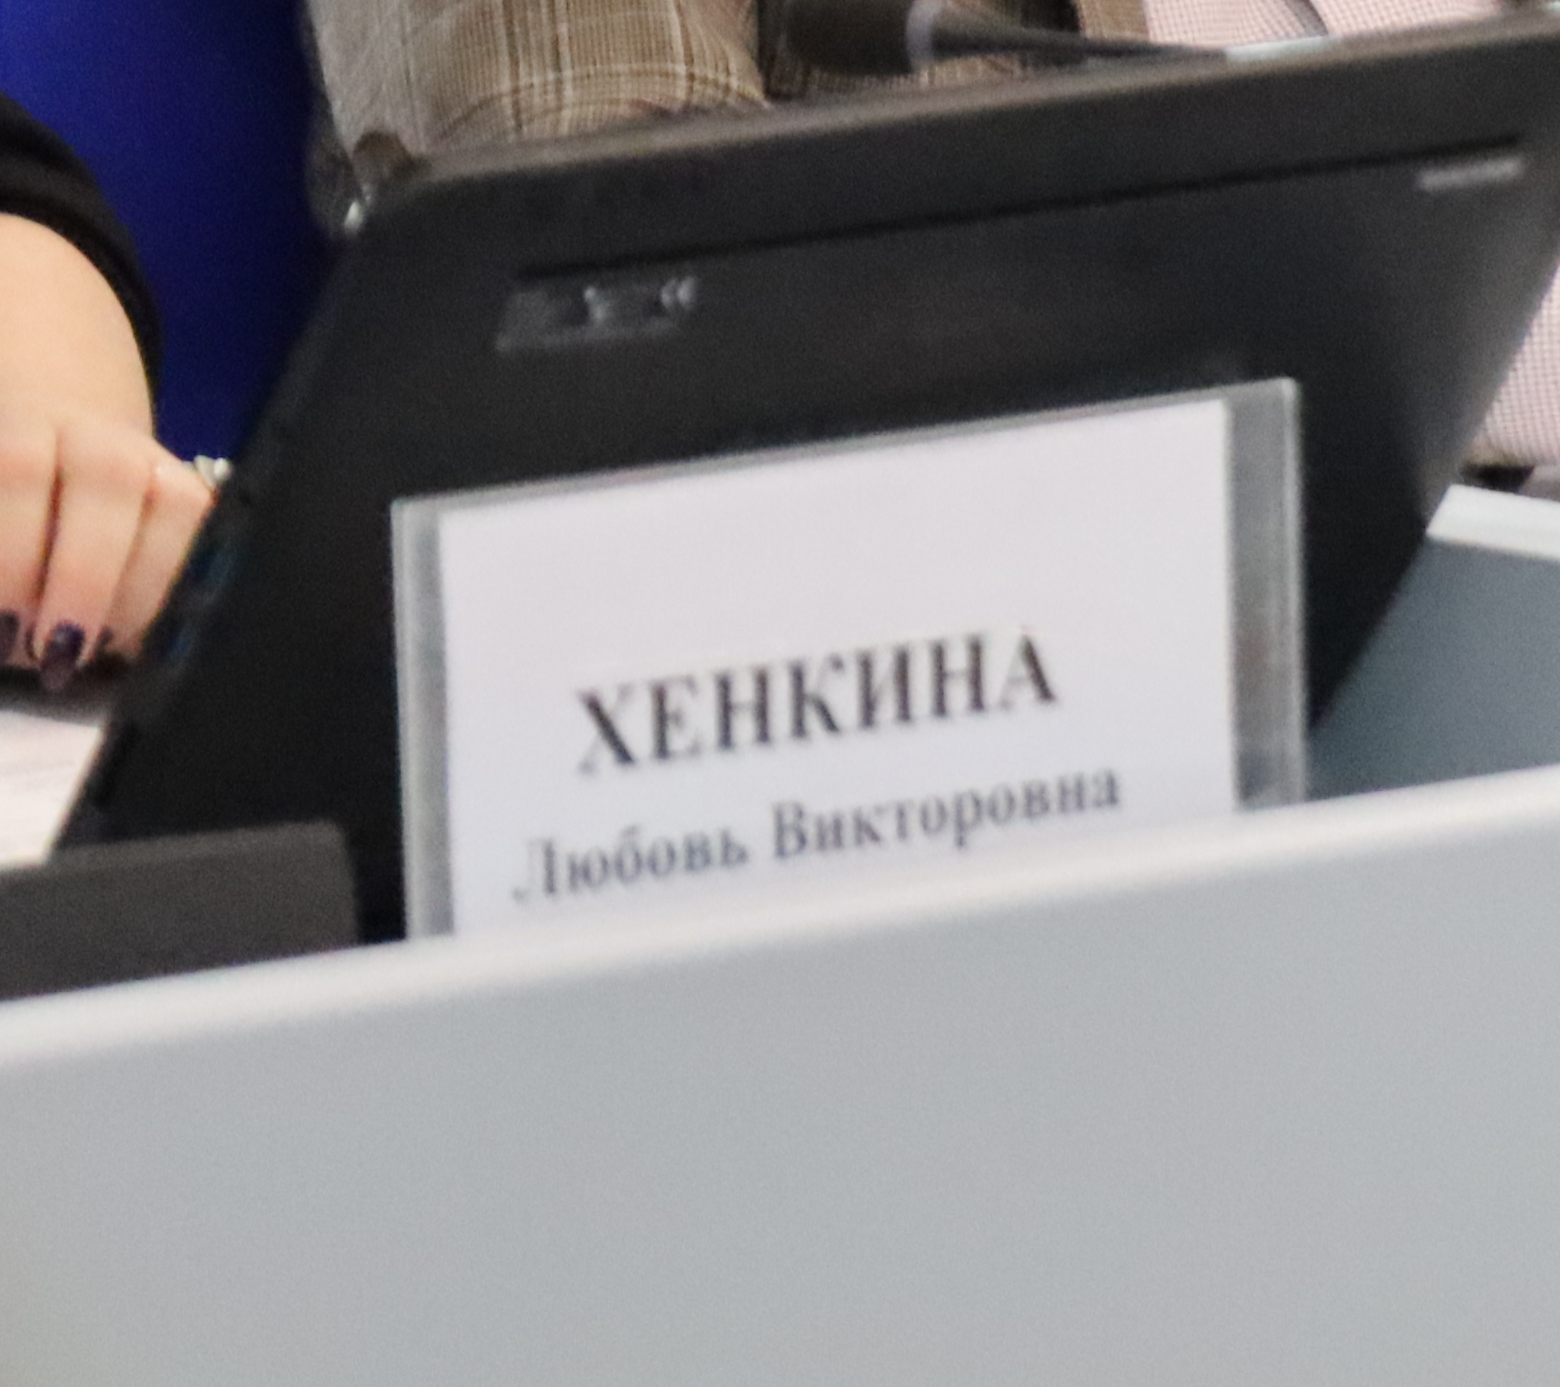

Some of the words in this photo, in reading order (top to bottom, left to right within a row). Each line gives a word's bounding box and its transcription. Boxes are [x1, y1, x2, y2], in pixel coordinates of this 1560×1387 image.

[578, 626, 1058, 774] ХЕНКИНА
[513, 823, 750, 901] Любовь
[771, 766, 1121, 858] Викторовна
